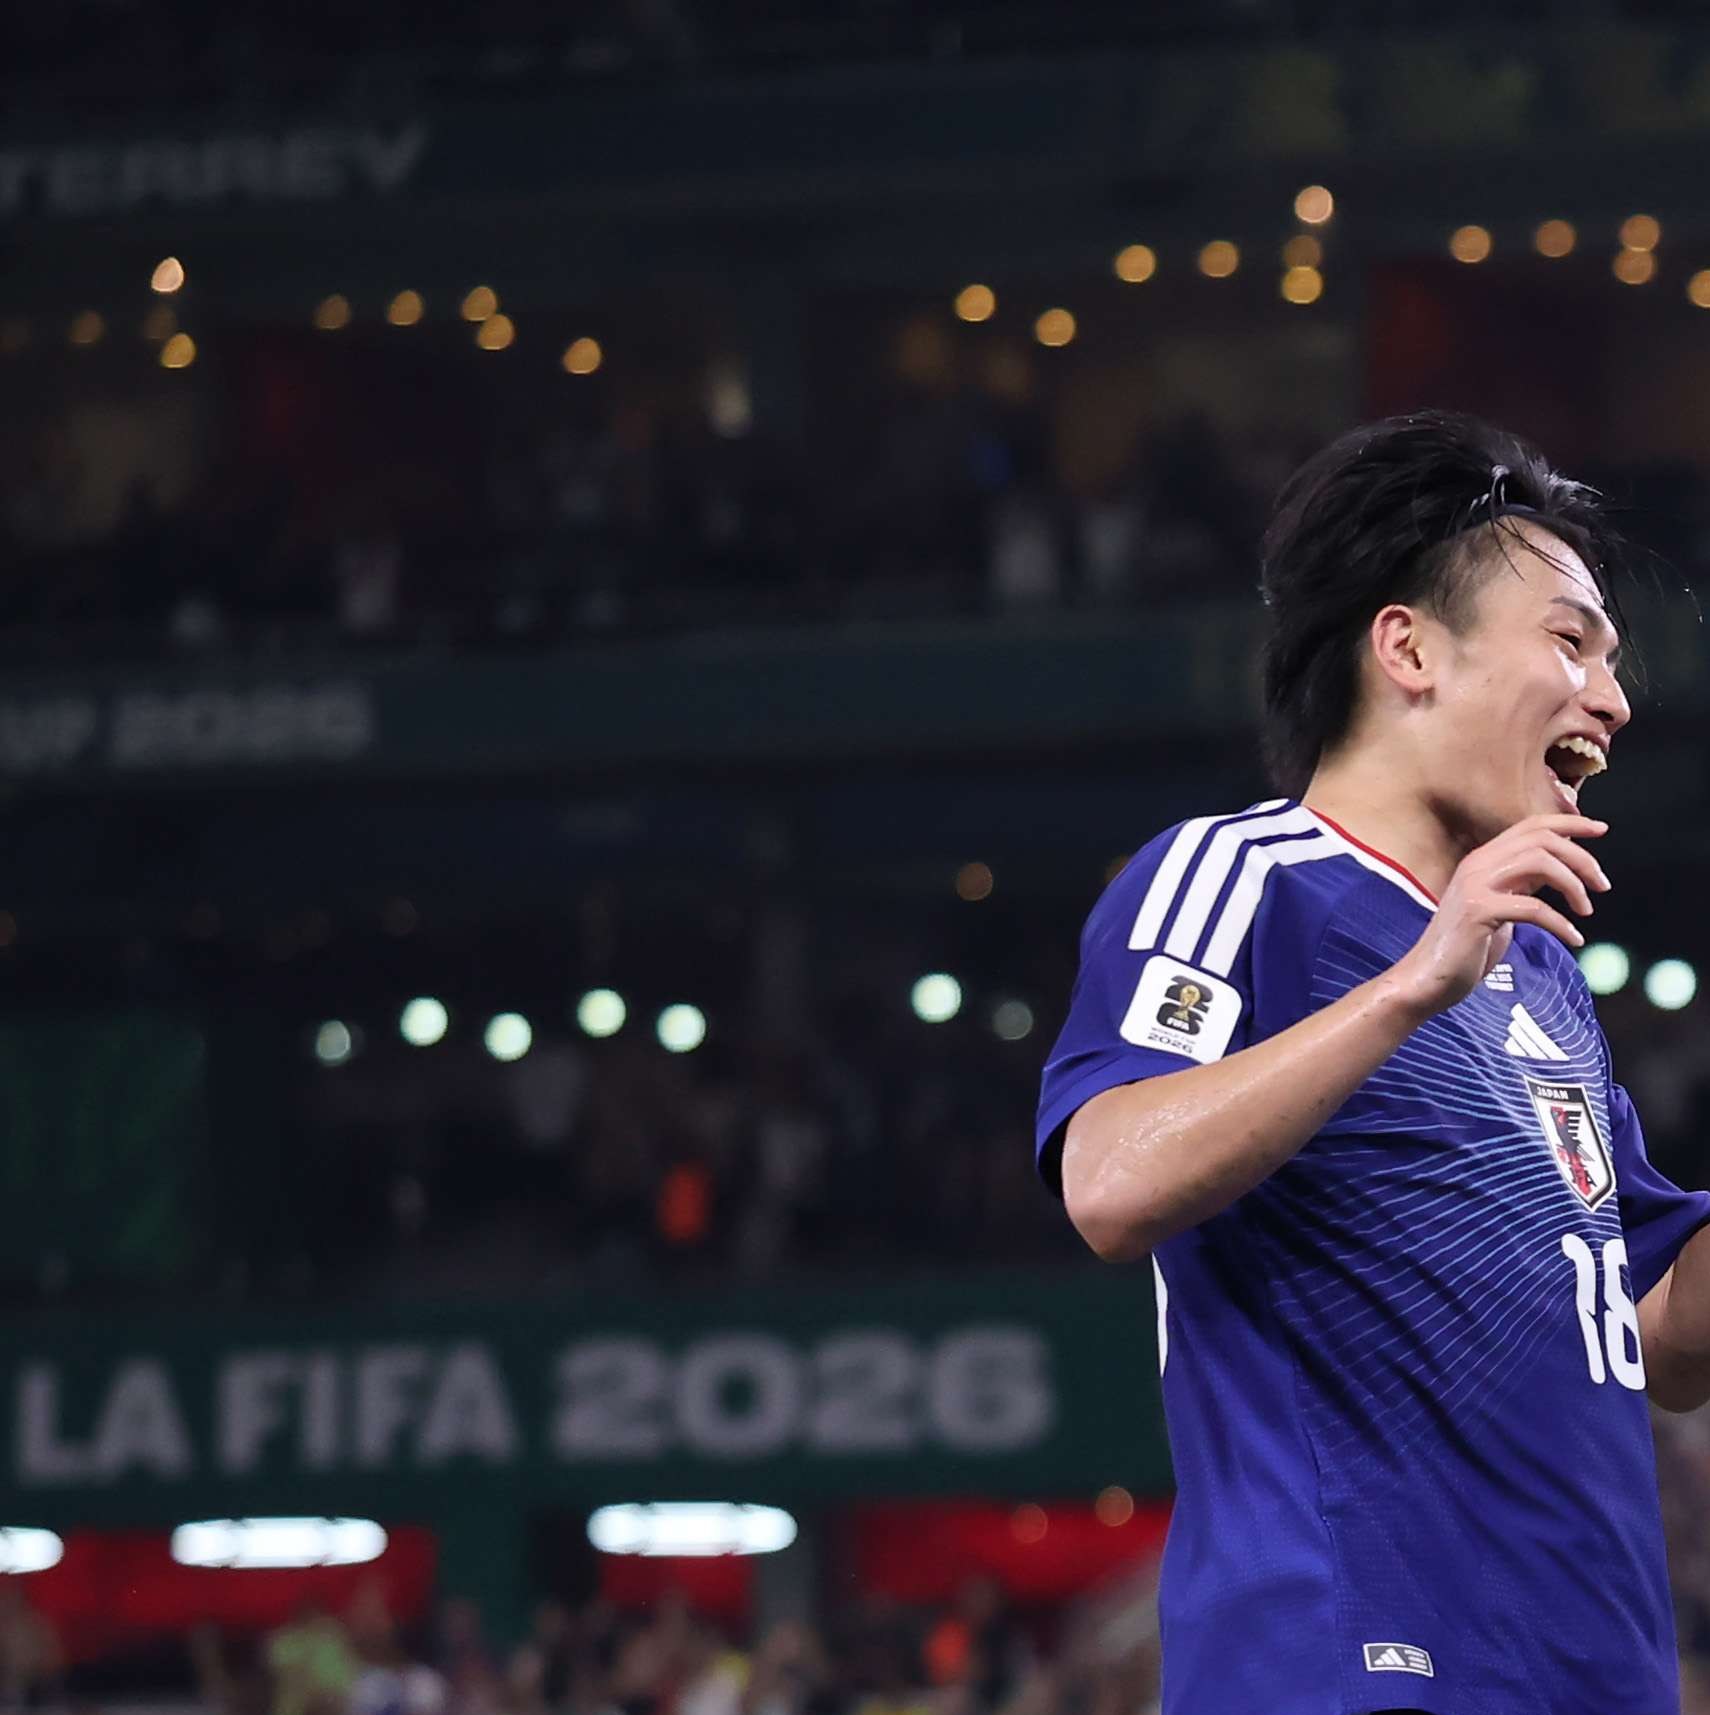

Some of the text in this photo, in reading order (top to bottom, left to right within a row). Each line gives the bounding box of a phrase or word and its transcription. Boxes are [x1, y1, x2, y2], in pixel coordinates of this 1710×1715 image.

[1147, 1031, 1194, 1055] 2026
[1536, 1086, 1569, 1100] JAPAN
[14, 1330, 1056, 1486] LA FIFA 2026
